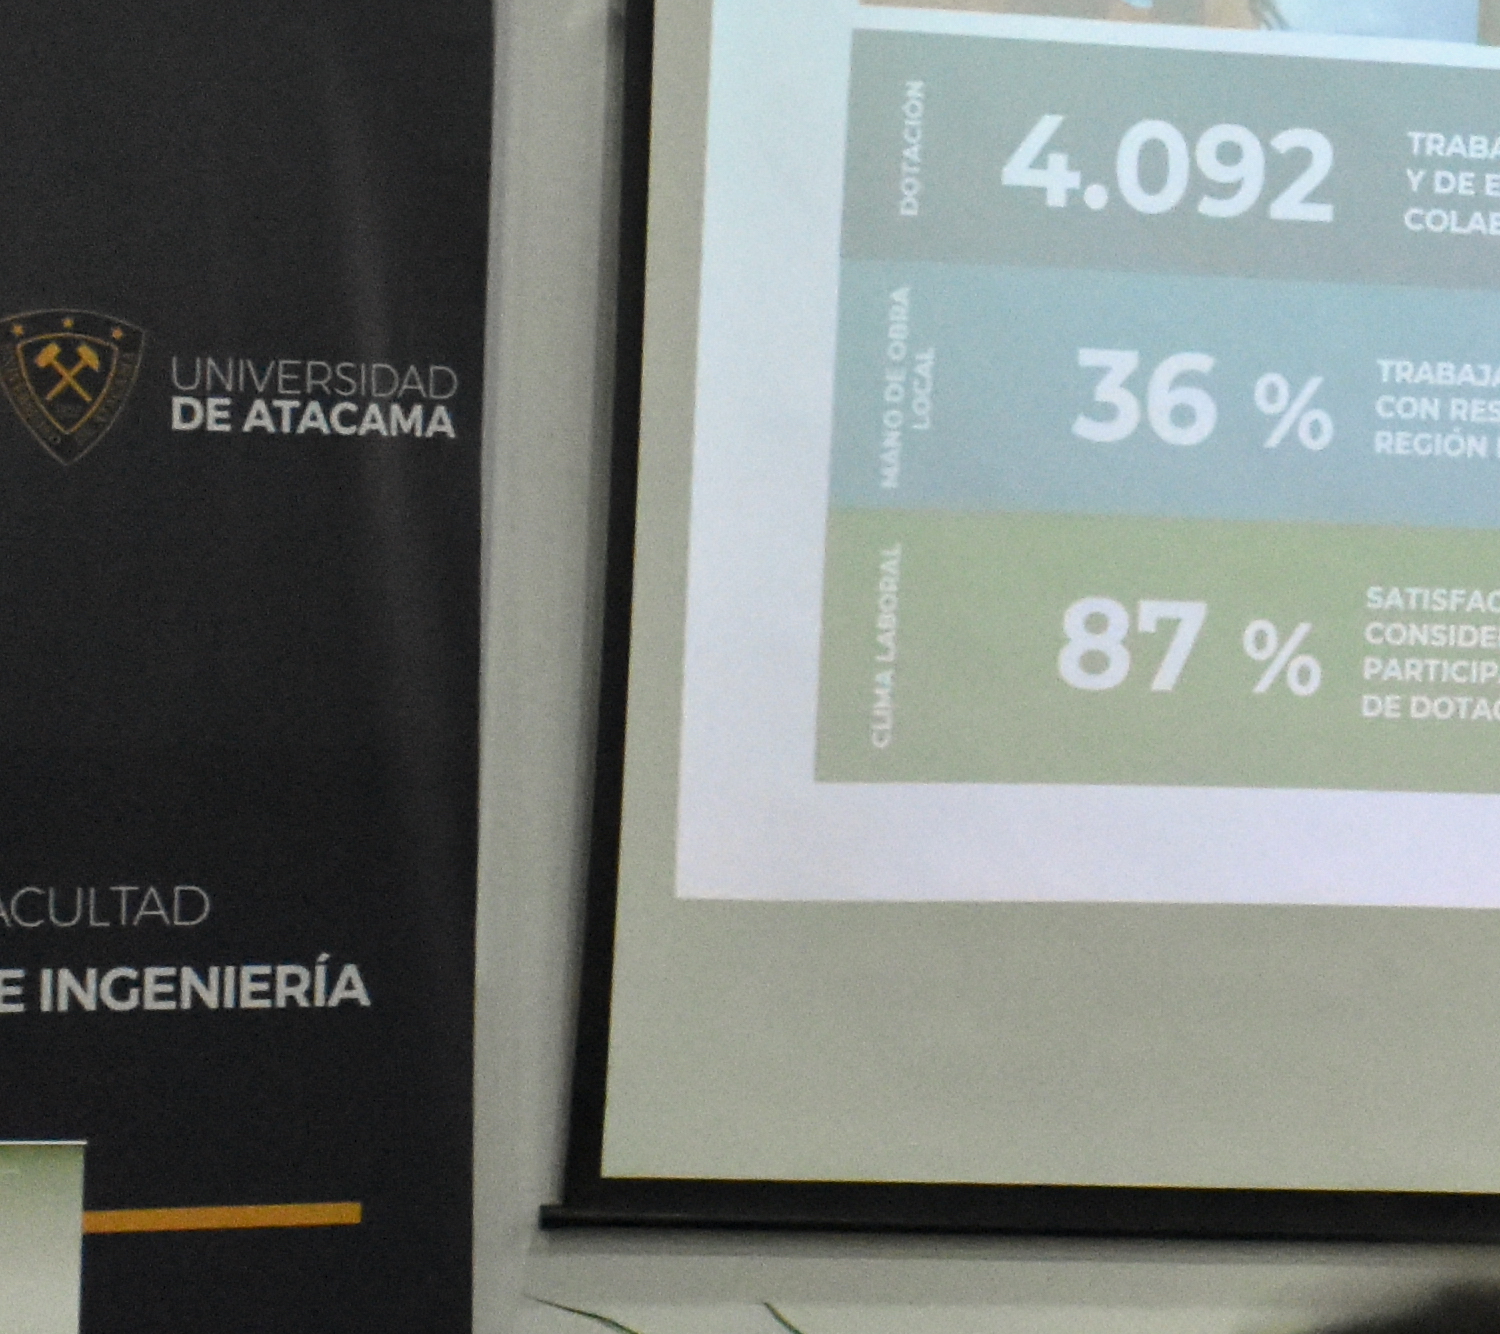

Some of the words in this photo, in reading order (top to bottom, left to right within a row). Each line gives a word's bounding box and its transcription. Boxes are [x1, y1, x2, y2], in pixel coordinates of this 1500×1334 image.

[1001, 113, 1334, 223] 4.092
[1405, 167, 1426, 193] Y
[1433, 168, 1476, 197] DE
[171, 355, 459, 401] UNIVERSIDAD
[884, 366, 907, 402] DE
[912, 347, 936, 430] LOCAL
[1072, 346, 1218, 447] 36
[1253, 371, 1334, 452] %
[171, 395, 232, 433] DE
[242, 397, 456, 439] ATACAMA
[1375, 394, 1441, 421] CON
[1373, 425, 1489, 459] REGIÓN
[875, 543, 902, 663] LABORAL
[1057, 595, 1208, 692] 87
[1242, 618, 1322, 698] %
[871, 670, 895, 749] CLIMA
[1361, 693, 1402, 720] DE
[40, 951, 371, 1013] INGENIERÍA
